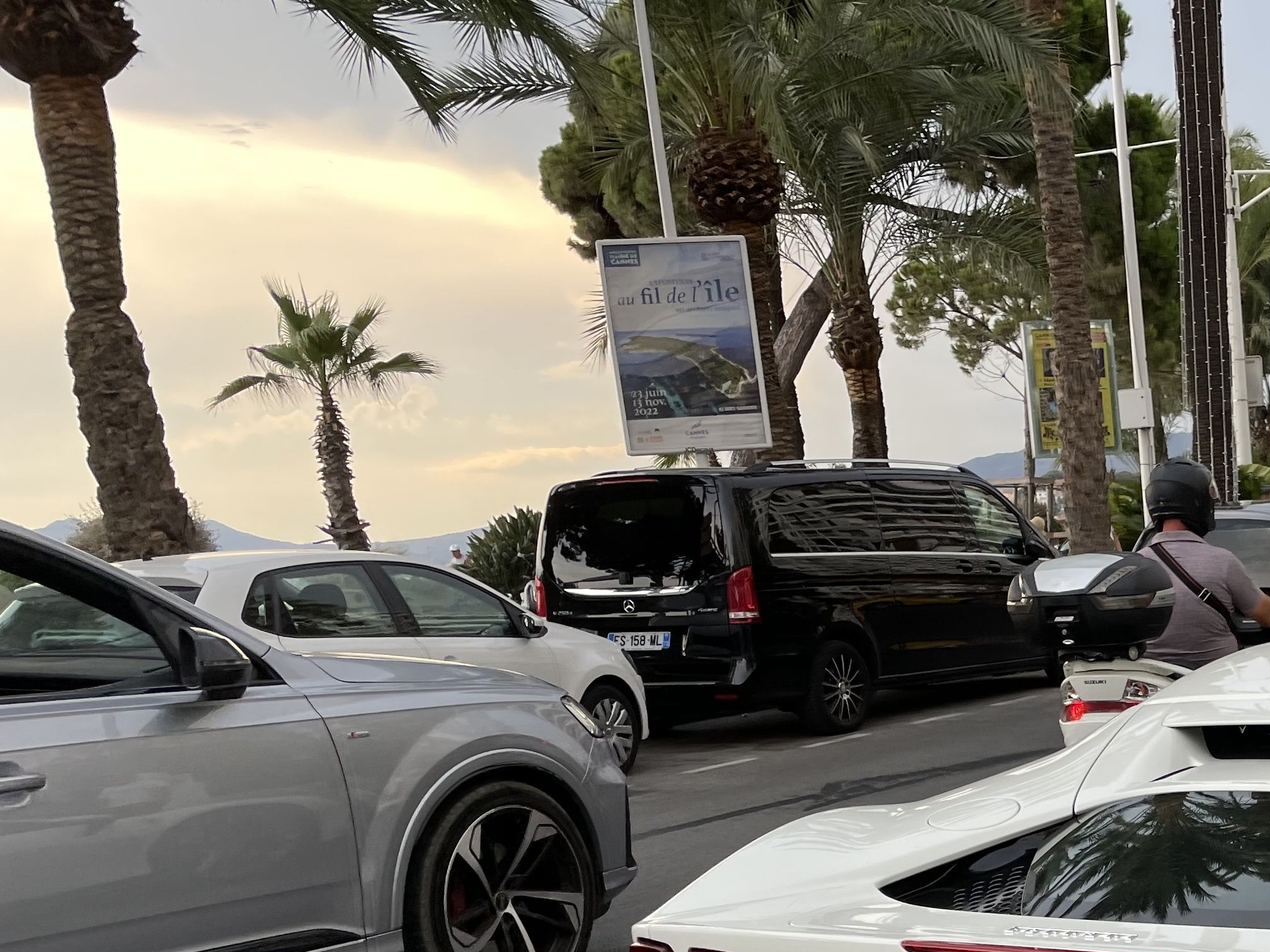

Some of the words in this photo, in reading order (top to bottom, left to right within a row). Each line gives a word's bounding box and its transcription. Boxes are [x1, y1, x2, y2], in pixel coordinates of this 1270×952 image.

[617, 296, 635, 306] au
[640, 287, 662, 305] fil
[666, 286, 686, 304] de
[631, 389, 643, 400] 23
[644, 387, 667, 401] juin
[645, 399, 667, 407] nov.
[634, 407, 659, 417] 2022
